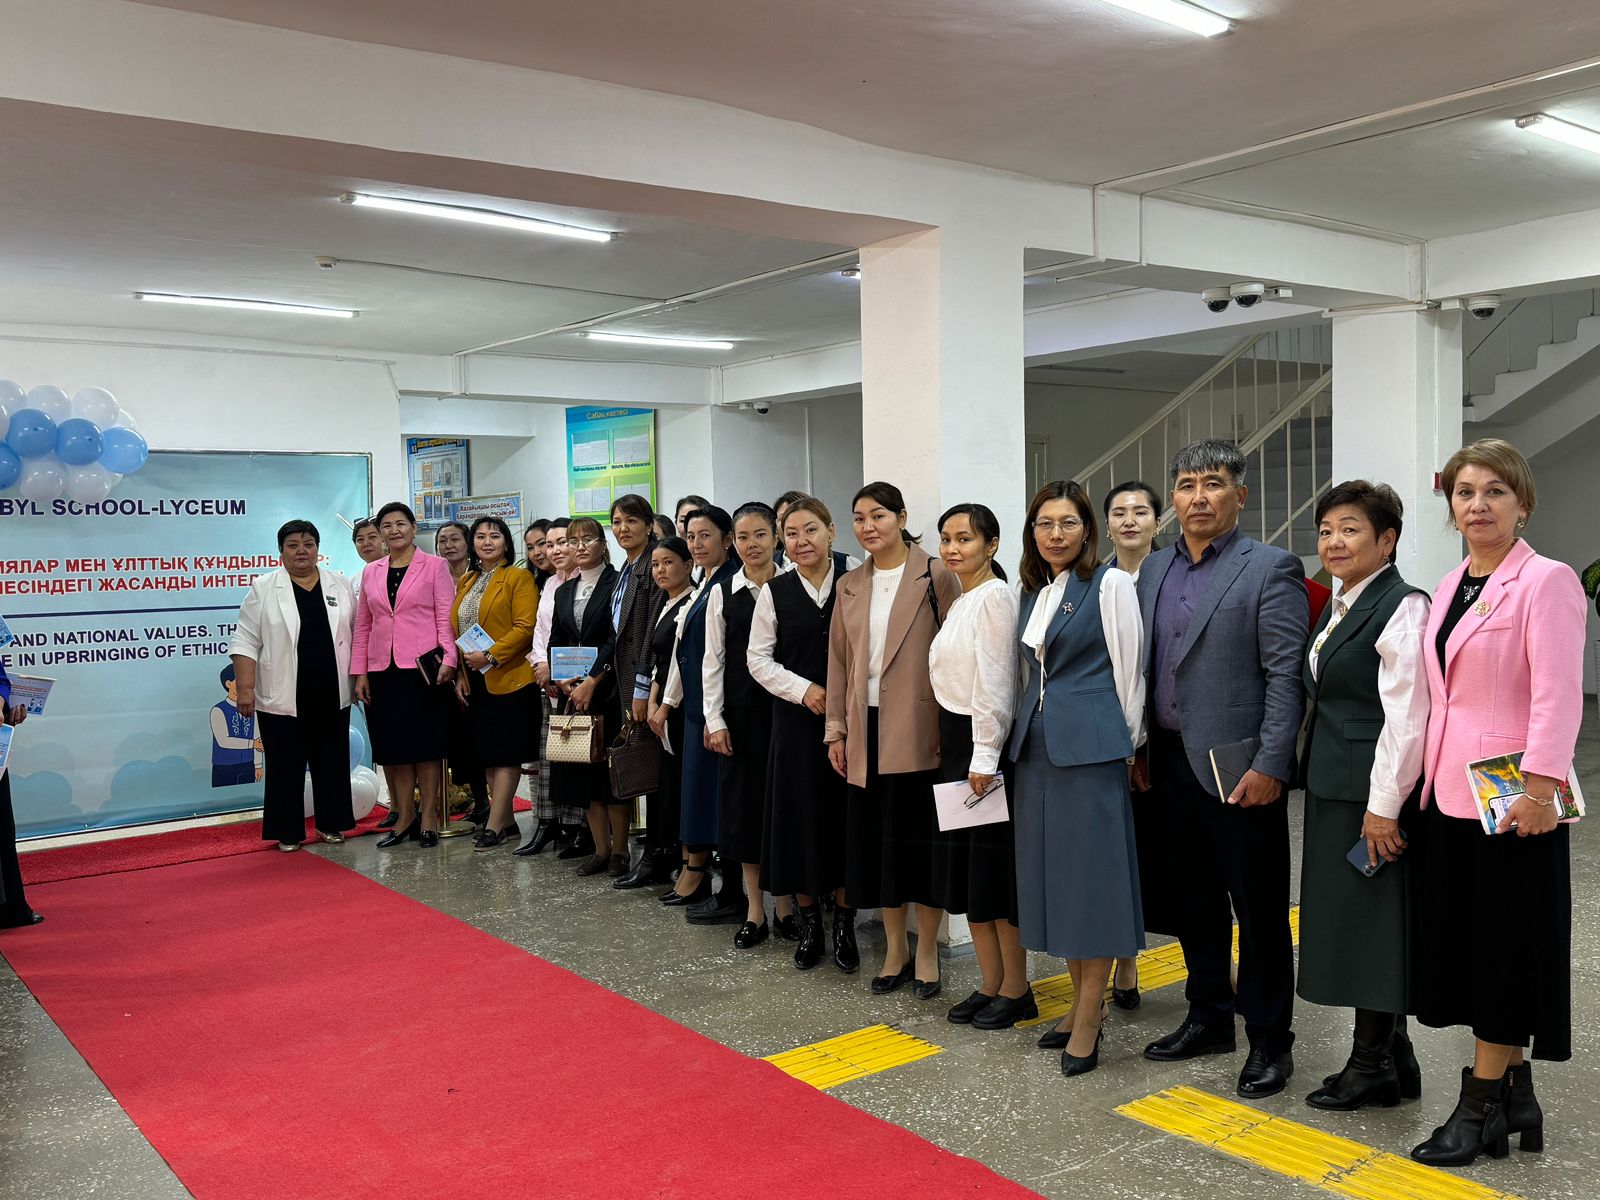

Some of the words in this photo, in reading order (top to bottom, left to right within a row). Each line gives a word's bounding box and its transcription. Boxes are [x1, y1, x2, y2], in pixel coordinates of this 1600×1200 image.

[52, 499, 246, 515] SCHOOL-LYCEUM
[66, 558, 106, 572] МЕН
[112, 556, 188, 573] ҰЛТТЫҚ
[0, 578, 92, 595] ЕСІНДЕГІ
[98, 576, 197, 591] ЖАСАНДЫ
[9, 633, 48, 648] AND
[53, 628, 140, 646] NATIONAL
[144, 625, 213, 641] VALUES.
[19, 653, 35, 667] IN
[42, 647, 149, 665] UPBRINGING
[155, 644, 176, 658] OF
